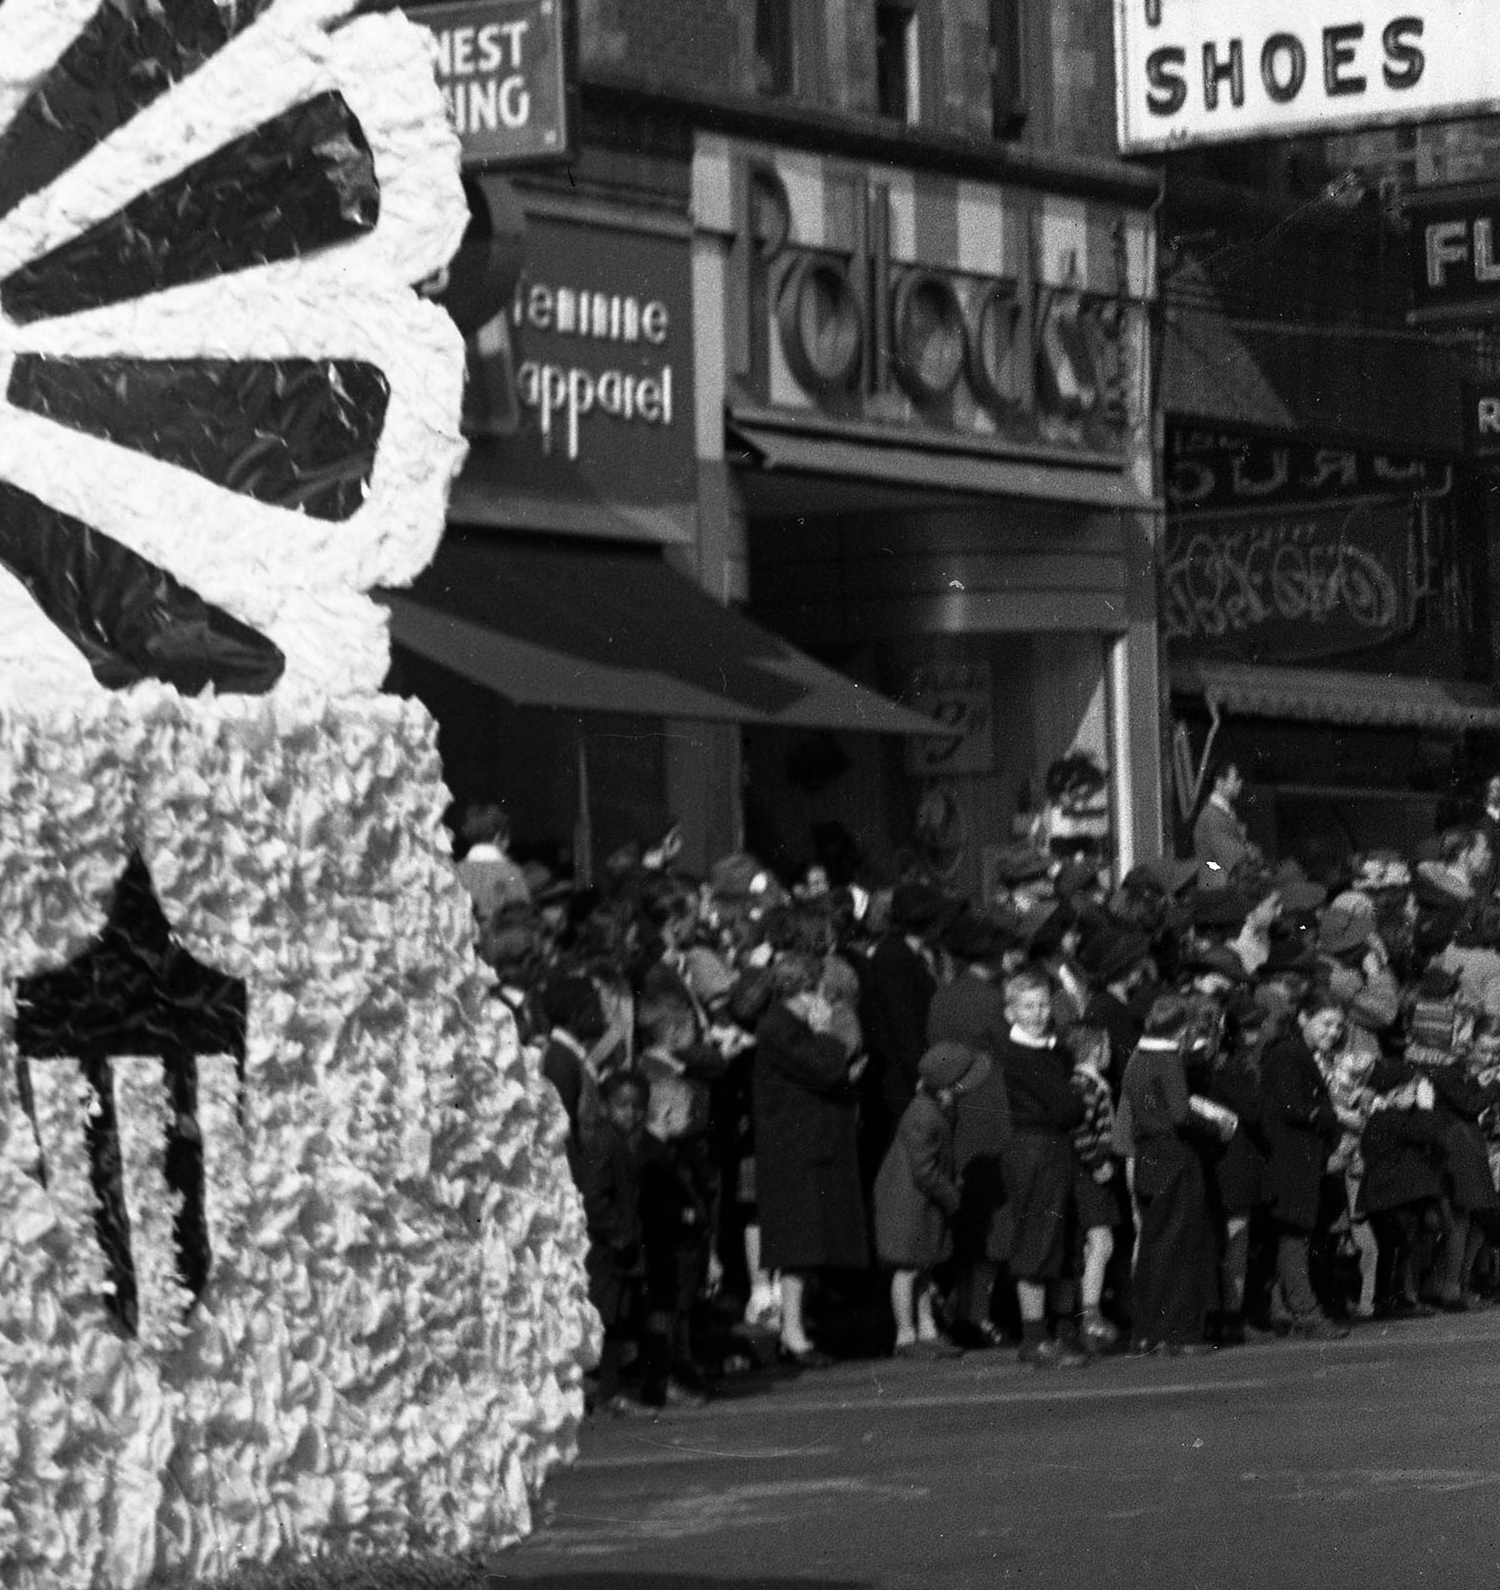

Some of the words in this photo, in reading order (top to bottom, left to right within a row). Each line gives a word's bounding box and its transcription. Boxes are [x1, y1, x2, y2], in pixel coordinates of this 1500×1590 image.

[442, 74, 530, 134] ING
[1145, 15, 1426, 117] SHOES
[517, 361, 673, 461] apparel
